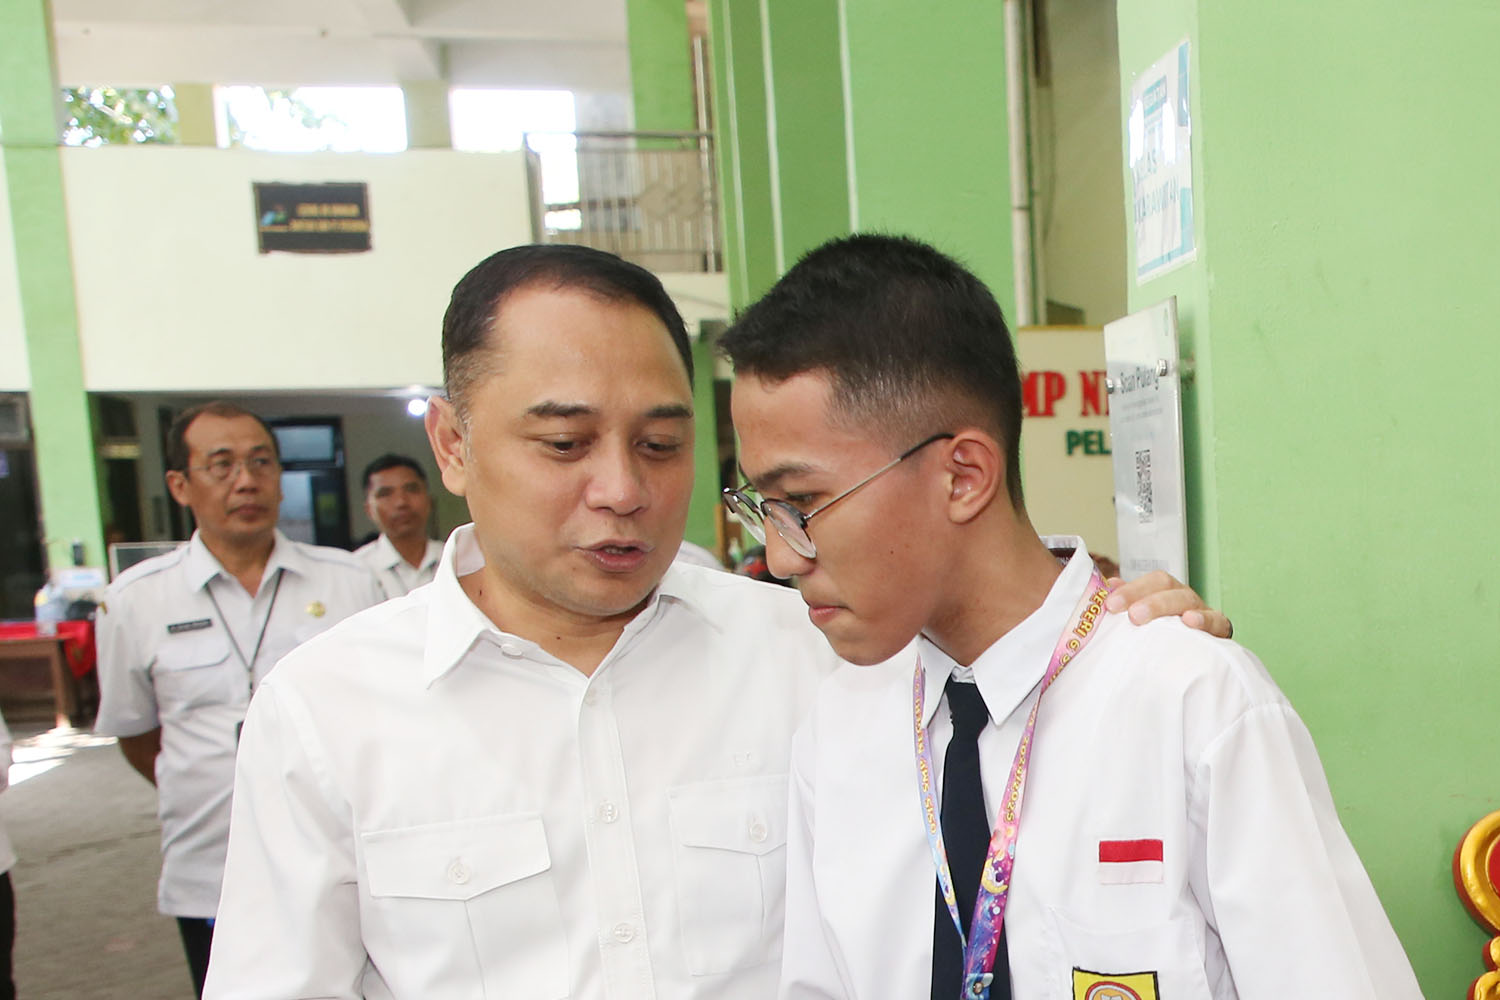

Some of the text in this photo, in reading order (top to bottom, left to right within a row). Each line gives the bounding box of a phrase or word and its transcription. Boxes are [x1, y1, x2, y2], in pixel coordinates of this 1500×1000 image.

[1022, 371, 1066, 417] MP
[1066, 429, 1112, 456] PEL
[1075, 588, 1110, 638] NEGERI
